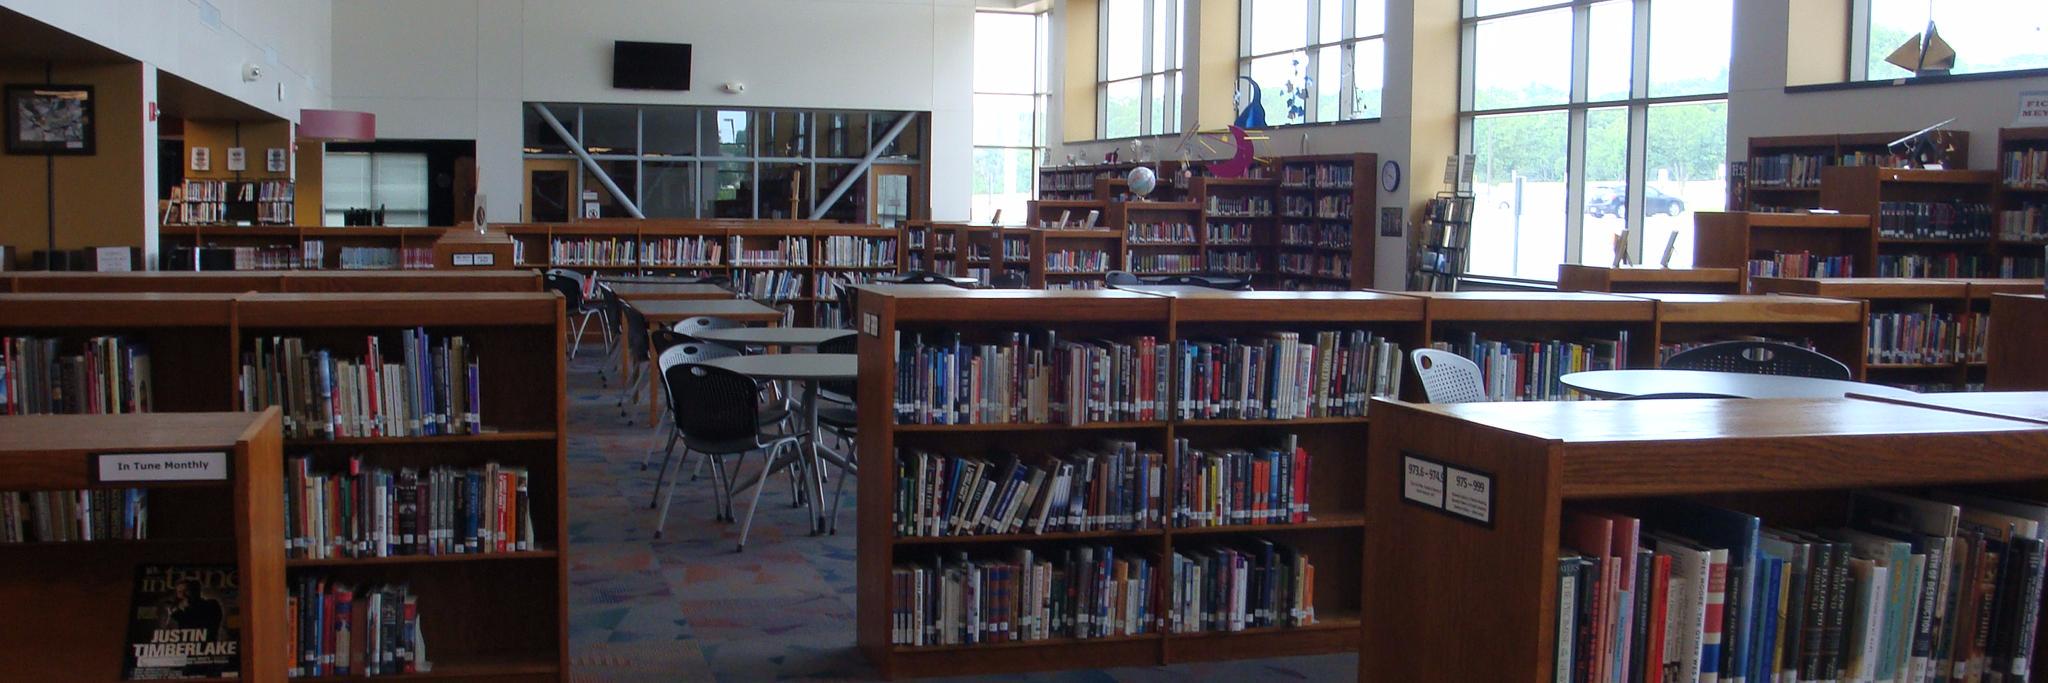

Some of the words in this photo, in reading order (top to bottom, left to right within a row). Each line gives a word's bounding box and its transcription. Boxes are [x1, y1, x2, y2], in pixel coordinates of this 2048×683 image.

[117, 462, 130, 471] In
[133, 461, 161, 470] Tune
[164, 459, 209, 471] Monthly
[1928, 548, 1940, 570] PATH
[1697, 578, 1705, 605] MOORE
[1920, 581, 1936, 634] DESTRUCTION
[151, 628, 208, 643] JUSTIN
[132, 641, 237, 658] TIMBERLAKE
